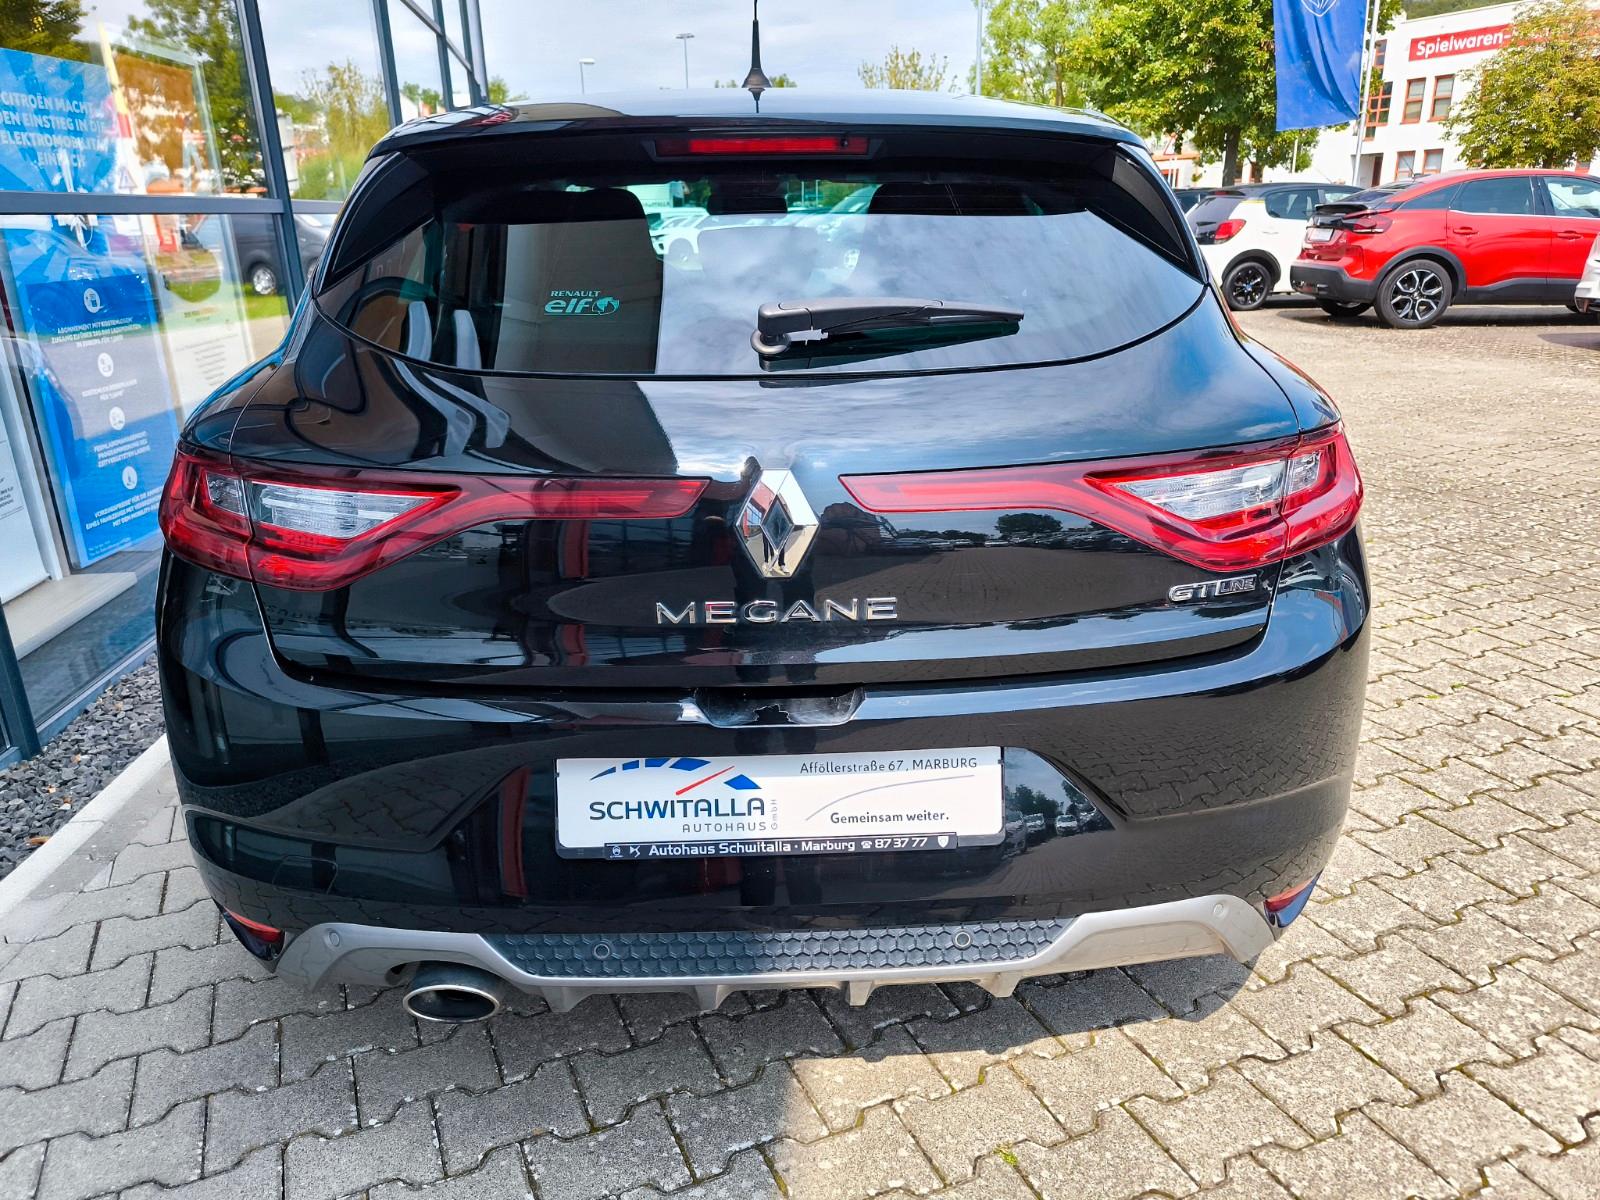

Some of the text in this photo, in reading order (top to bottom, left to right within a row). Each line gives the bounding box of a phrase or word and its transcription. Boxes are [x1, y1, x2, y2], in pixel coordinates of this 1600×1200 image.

[1416, 33, 1511, 58] Spielwaren-
[1, 91, 53, 110] CITROËN
[22, 112, 74, 131] EINSTIEG
[76, 118, 88, 131] IN
[37, 151, 86, 168] EINCH
[544, 298, 593, 313] elf
[655, 596, 898, 625] MEGANE
[800, 760, 885, 775] Afföllerstraße
[912, 757, 978, 771] MARBURG
[589, 797, 766, 821] SCHWITALLA
[830, 809, 950, 824] Gemeinsam weiter.
[682, 821, 768, 833] AUTOHAUS
[648, 842, 716, 857] Autohaus
[718, 840, 791, 855] Schwitalla
[801, 839, 856, 852] Marburg
